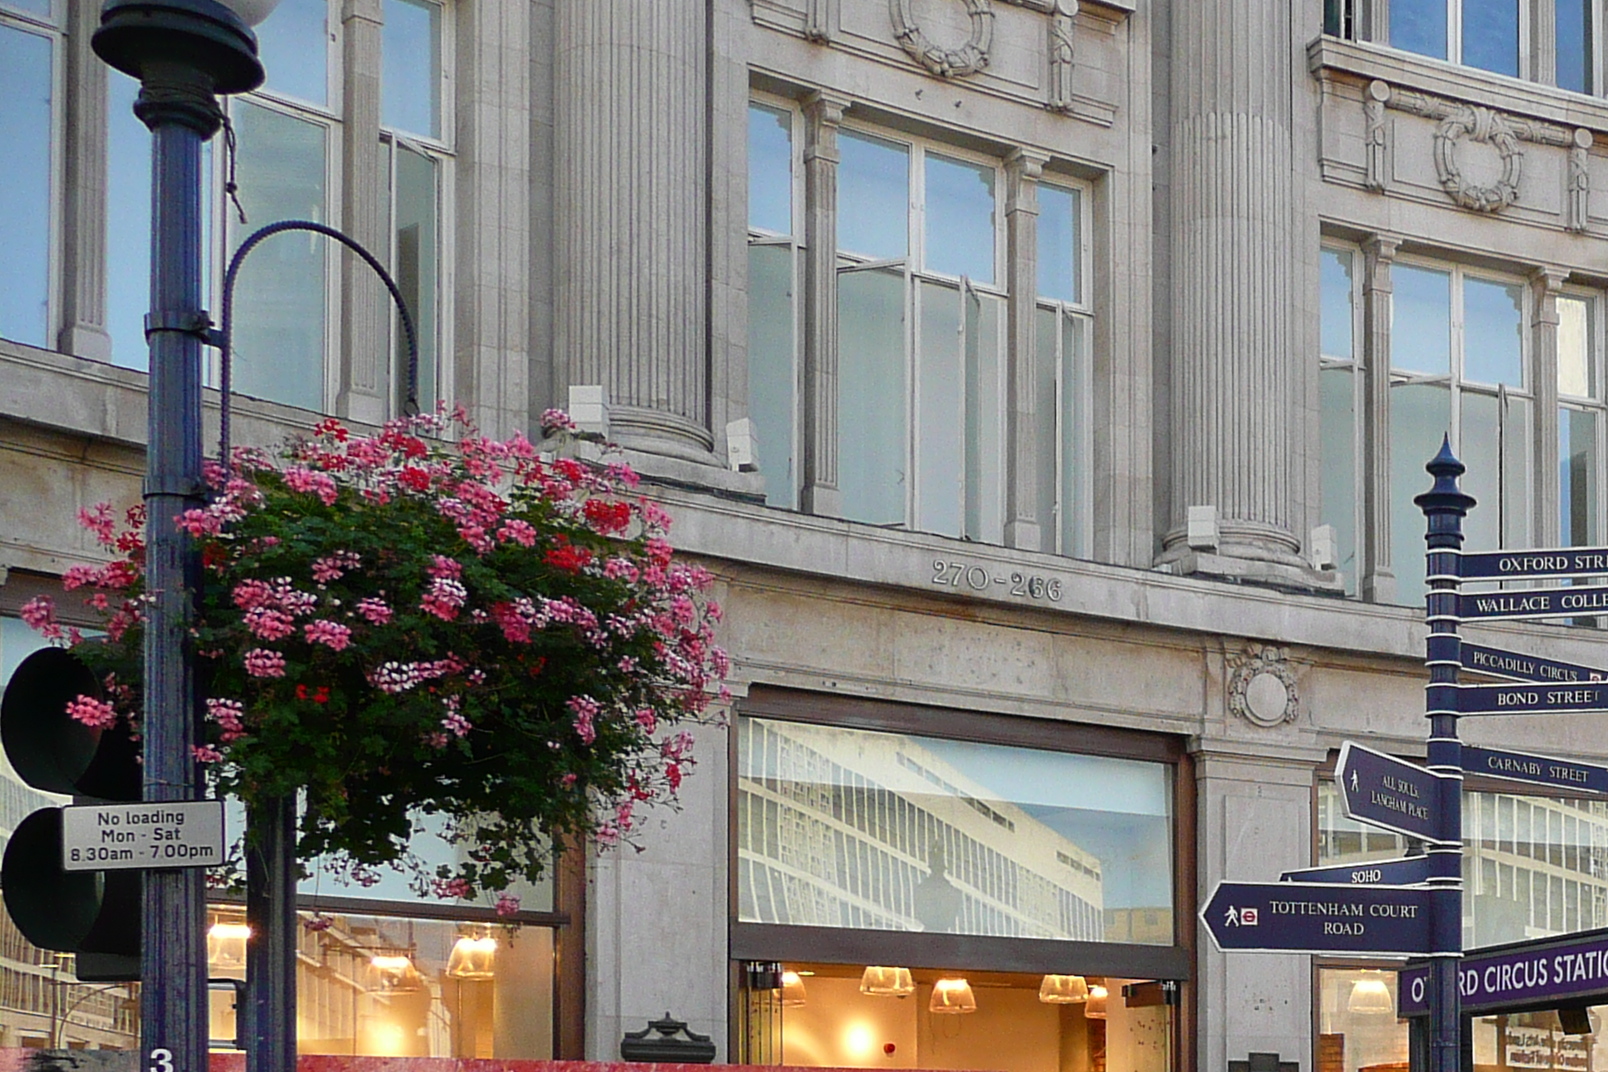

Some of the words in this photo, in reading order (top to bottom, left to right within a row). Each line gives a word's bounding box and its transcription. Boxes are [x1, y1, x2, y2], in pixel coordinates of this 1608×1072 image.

[1499, 556, 1568, 572] OXFORD
[1476, 596, 1550, 612] WALLACE
[1473, 651, 1536, 674] PICCADILLY
[1540, 664, 1578, 681] CIRCUS
[1498, 692, 1538, 706] BOND
[1488, 756, 1543, 775] CARNABY
[1549, 764, 1589, 783] STREET
[1382, 775, 1396, 791] ALL
[1371, 790, 1406, 812] LANGHAM
[1408, 801, 1428, 820] PLACE
[98, 812, 120, 826] No
[126, 810, 185, 825] loading
[102, 829, 135, 843] Mon
[153, 827, 181, 842] Sat
[71, 847, 133, 862] 8.30am
[149, 844, 213, 860] 7.00pm
[1351, 870, 1381, 883] SOHO
[1269, 901, 1364, 917] TOTTENHAM
[1370, 905, 1418, 918] COURT
[1324, 922, 1364, 935] ROAD
[1411, 969, 1478, 1003] ORD
[1484, 958, 1548, 993] CIRCUS
